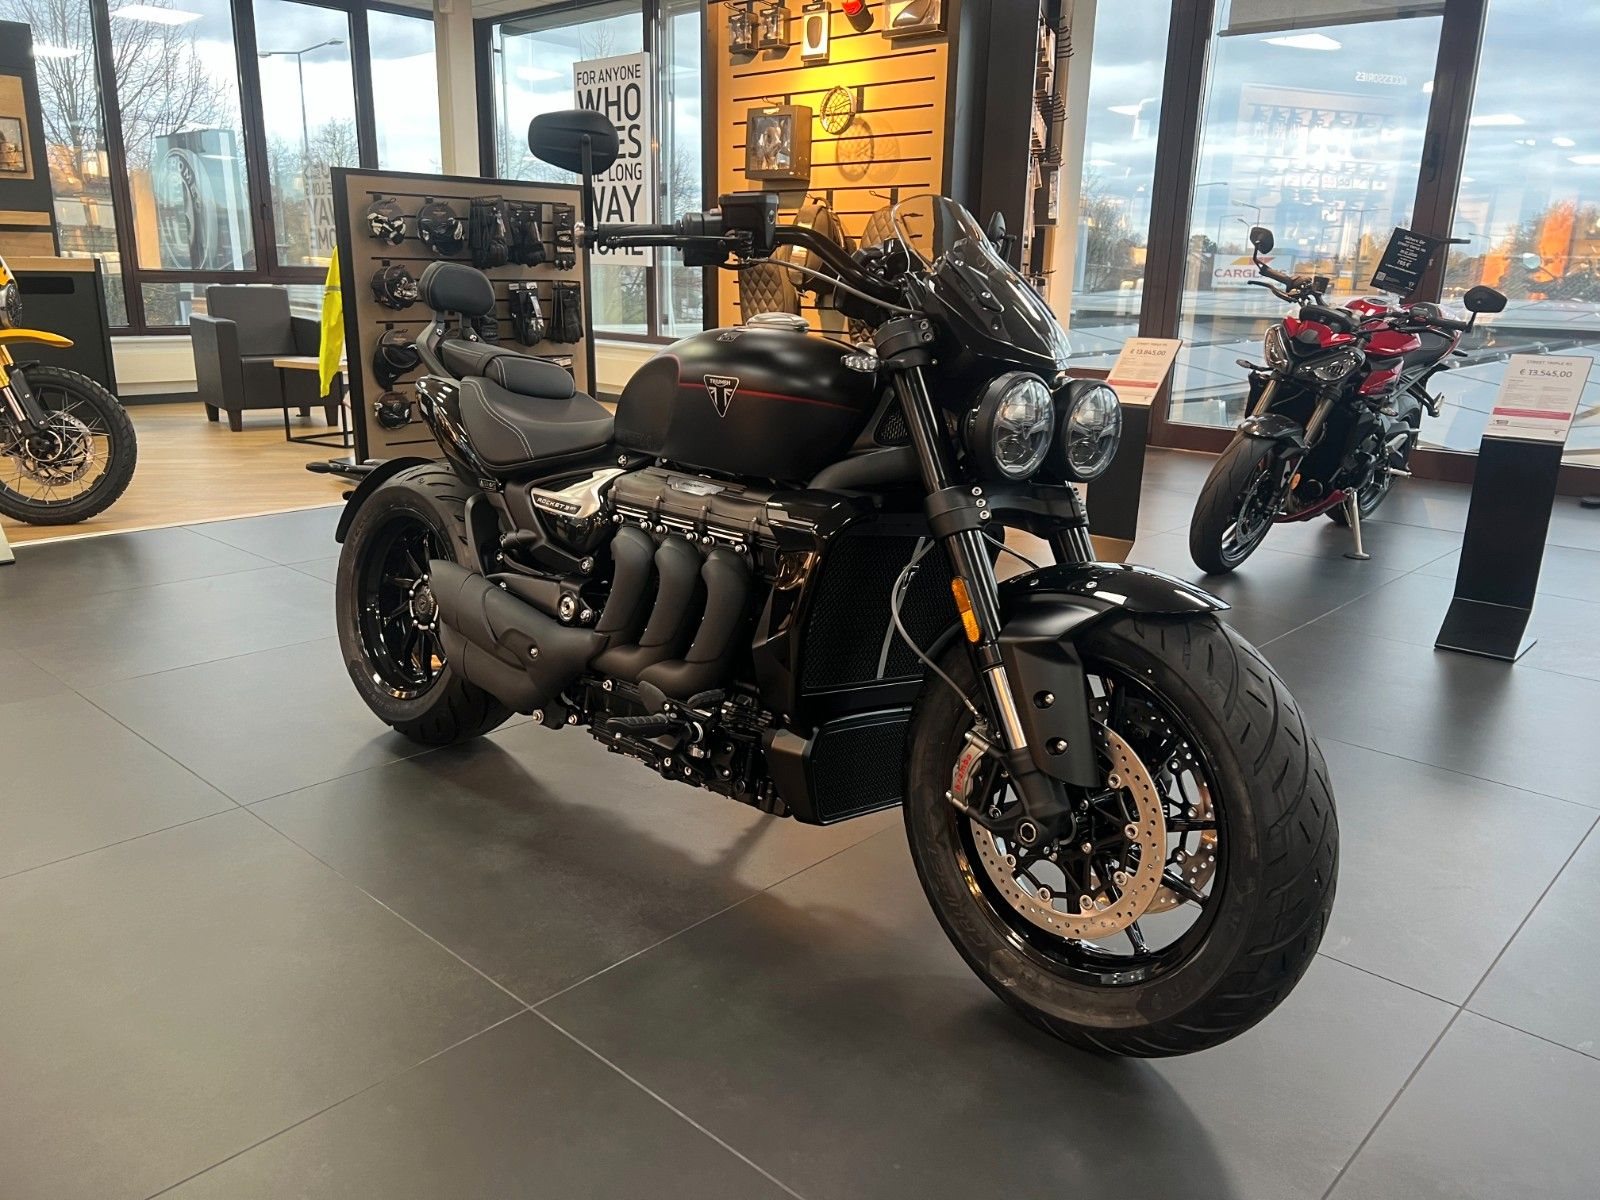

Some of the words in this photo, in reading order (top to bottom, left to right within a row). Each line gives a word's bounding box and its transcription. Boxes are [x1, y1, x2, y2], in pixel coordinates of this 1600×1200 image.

[577, 70, 596, 86] FOR
[598, 63, 641, 82] ANYONE
[577, 82, 642, 122] WHO
[608, 163, 642, 182] LONG
